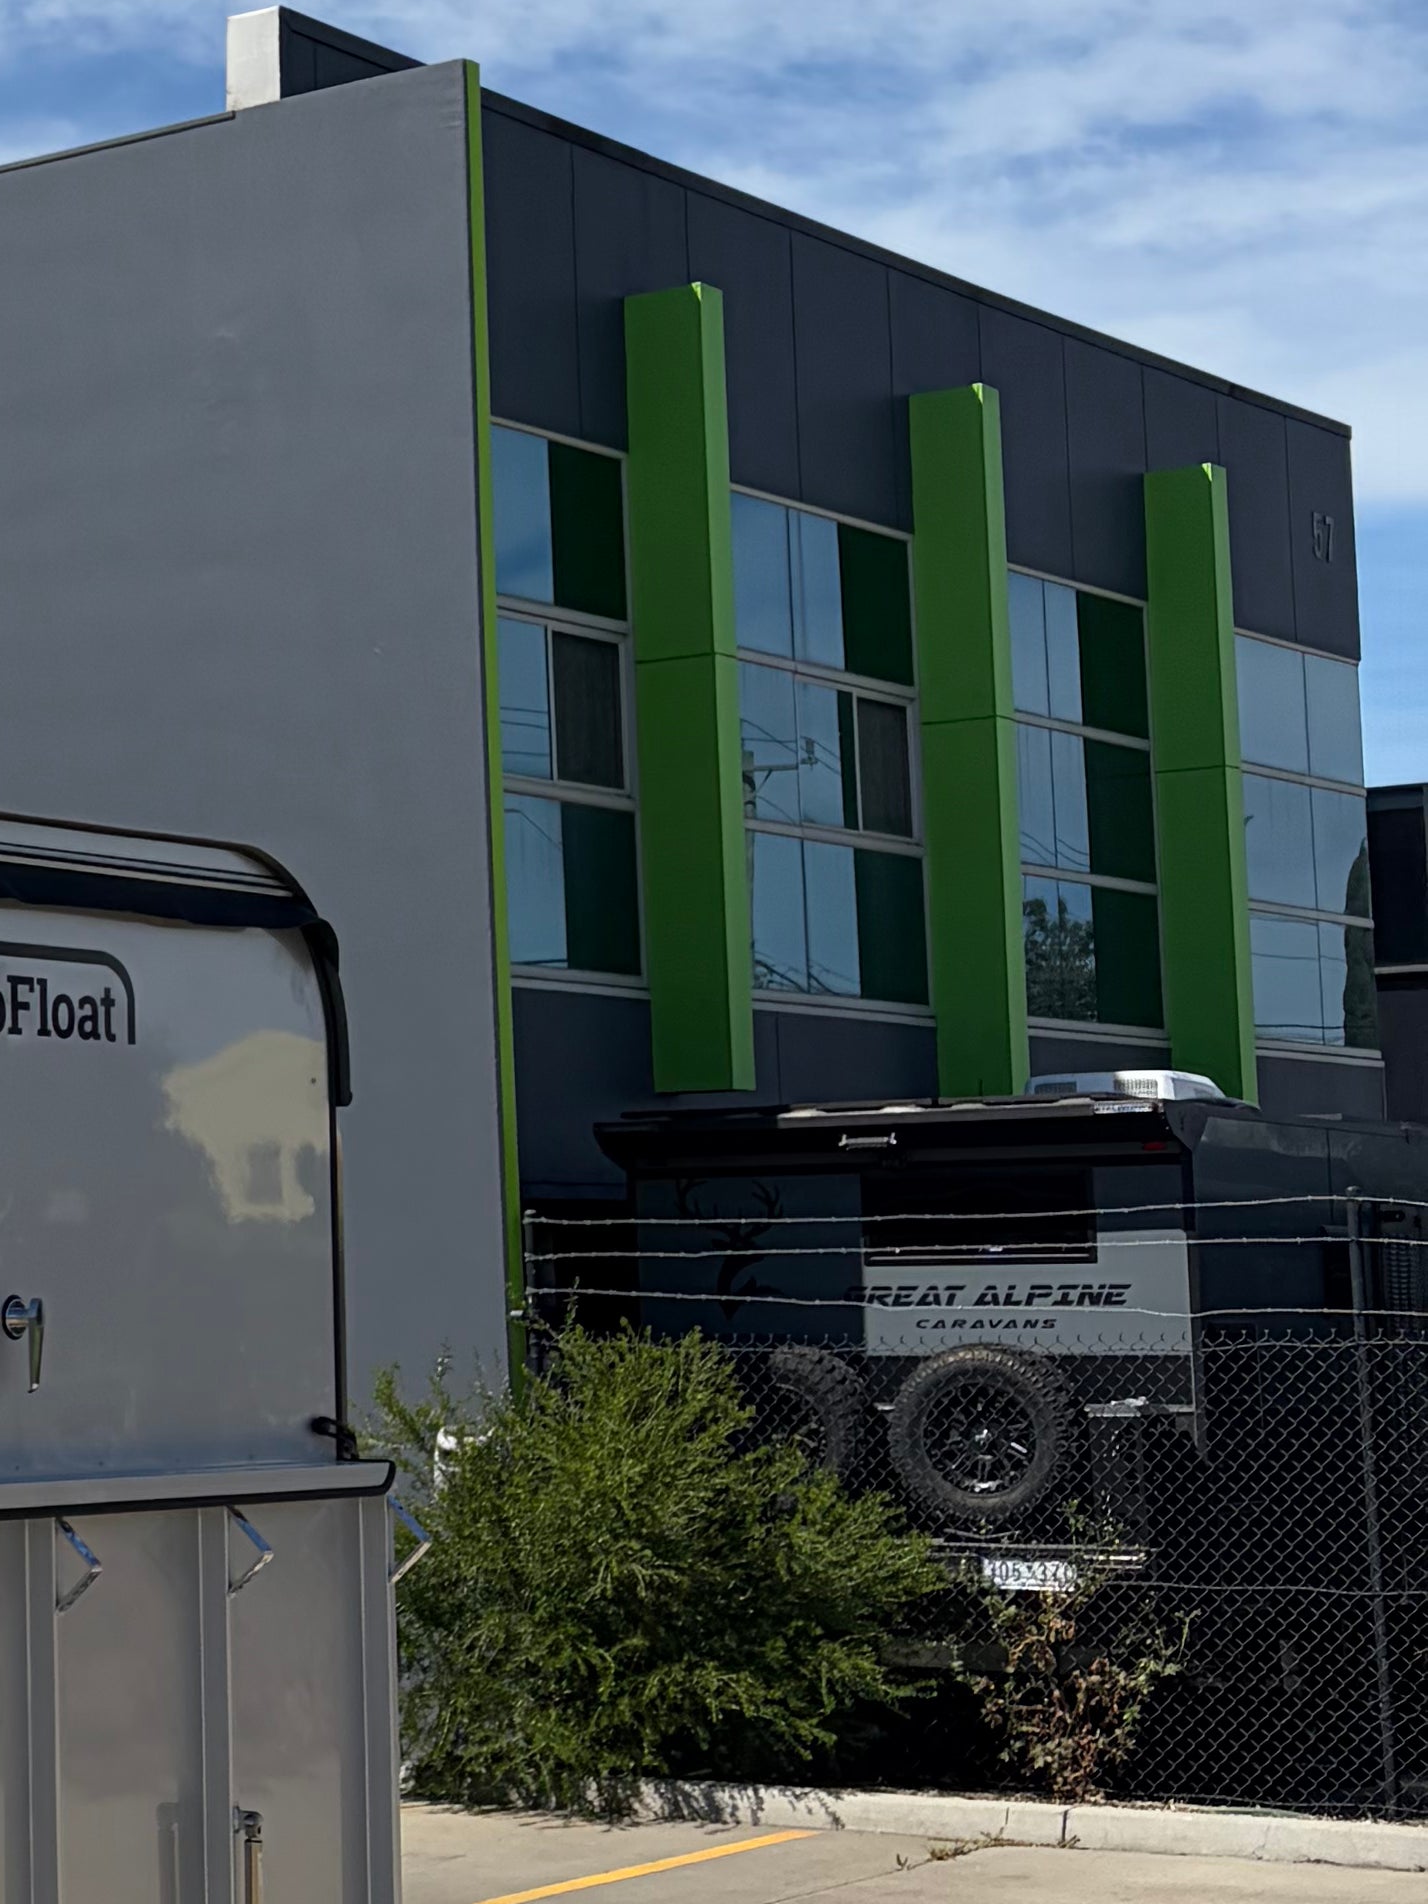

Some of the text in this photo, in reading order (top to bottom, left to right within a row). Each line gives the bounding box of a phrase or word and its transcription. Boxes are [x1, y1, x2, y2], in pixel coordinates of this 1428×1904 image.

[1311, 511, 1335, 564] 57
[843, 1283, 1132, 1307] GREAT ALPINE
[915, 1318, 1057, 1329] CARAVANS
